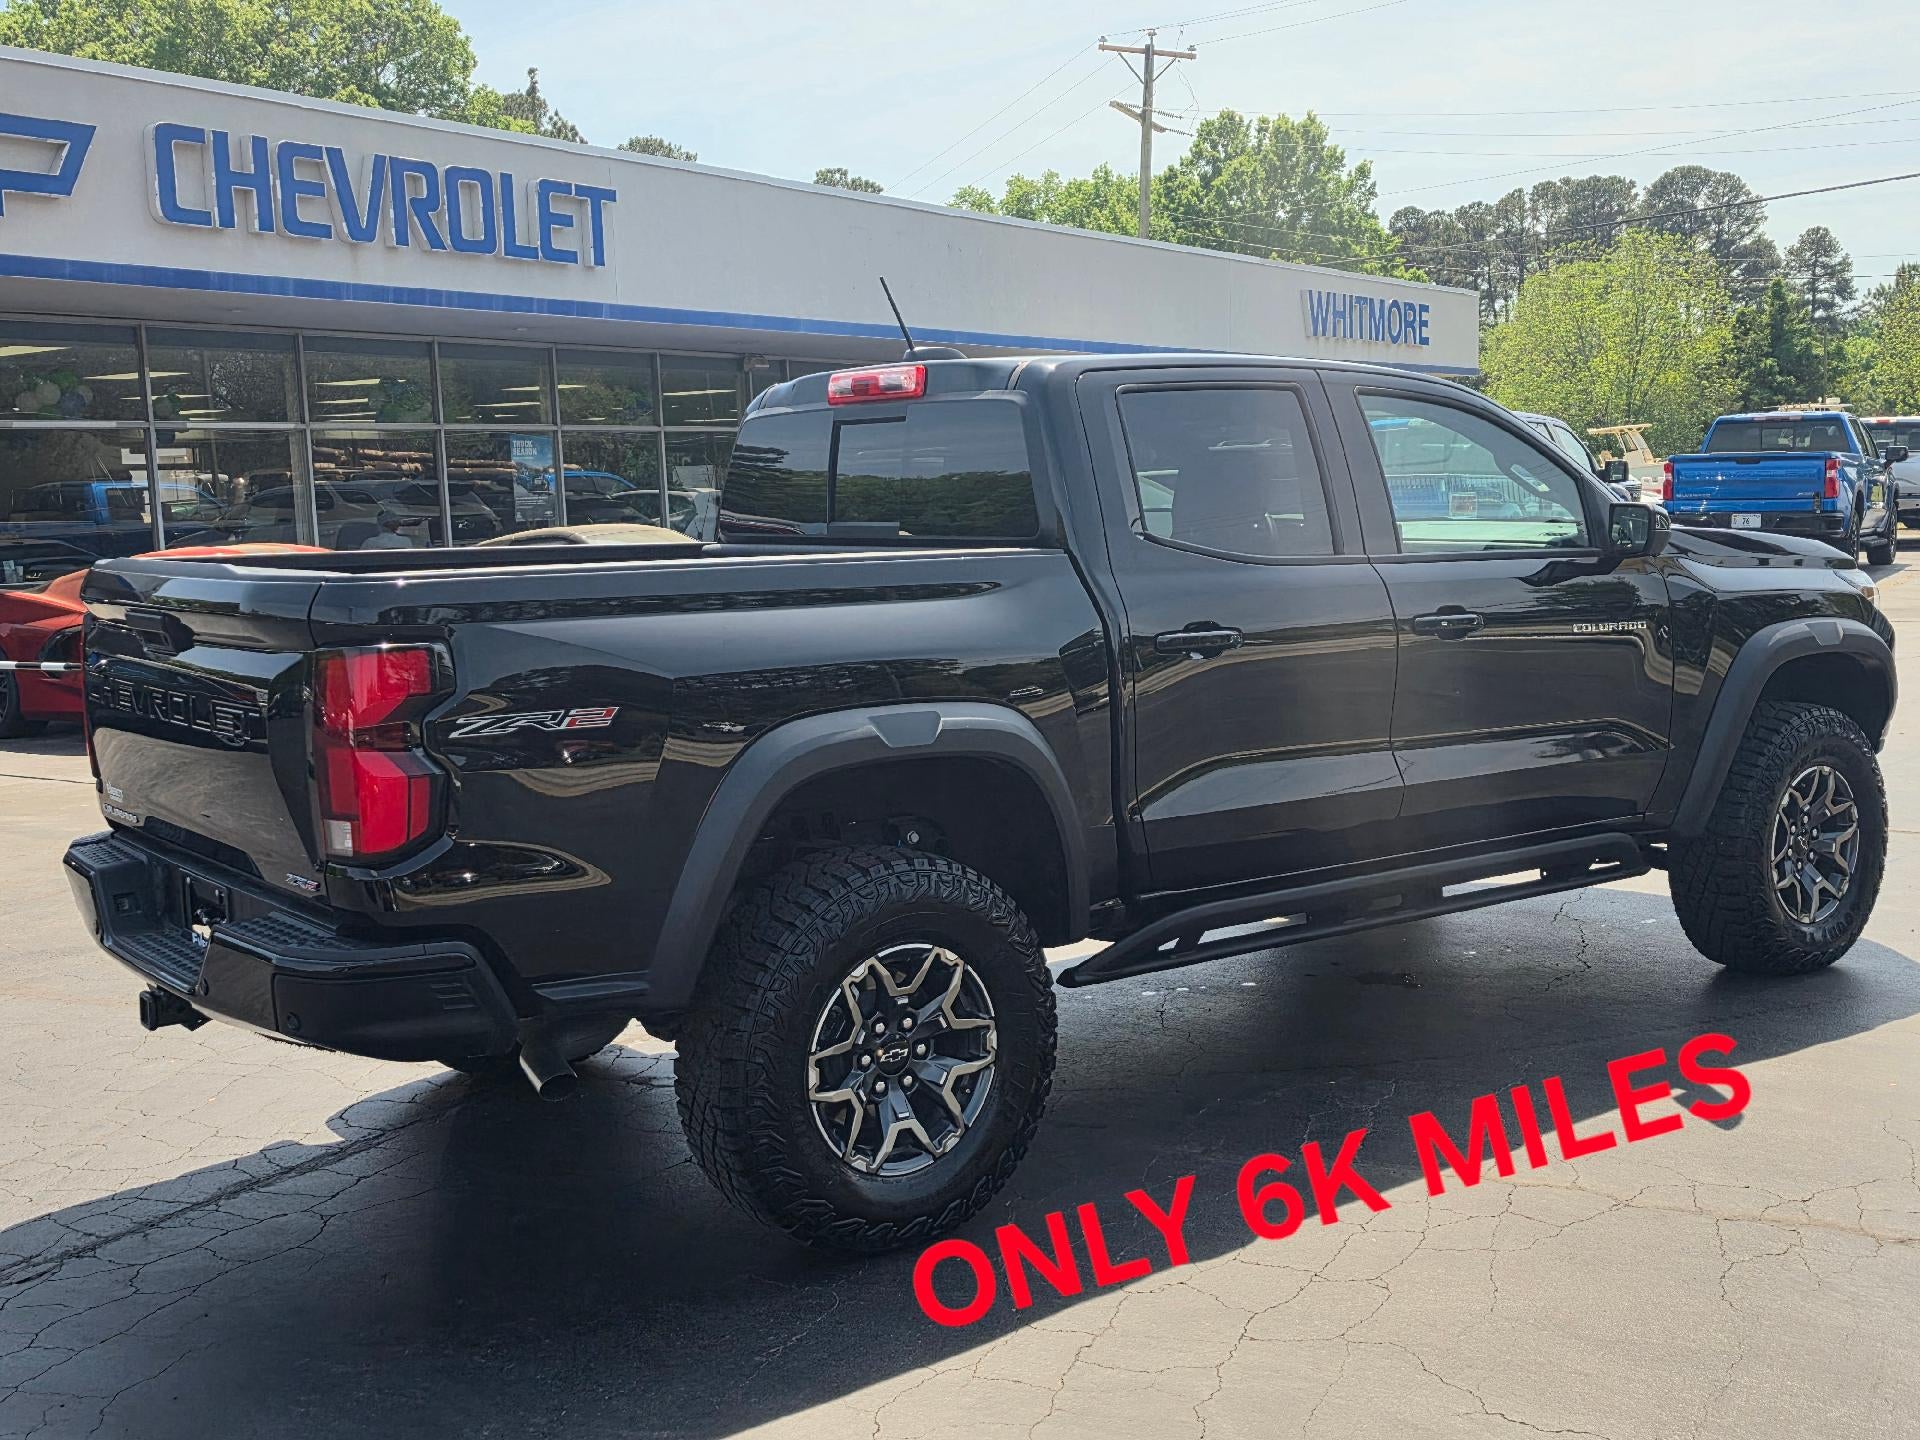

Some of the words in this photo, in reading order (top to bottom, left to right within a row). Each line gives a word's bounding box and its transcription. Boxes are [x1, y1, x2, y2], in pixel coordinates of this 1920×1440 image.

[152, 121, 617, 268] CHEVROLET
[1306, 289, 1430, 346] WHITMORE
[512, 439, 533, 448] TRUCK
[1573, 621, 1647, 633] COLORADO
[448, 706, 620, 739] ZR2
